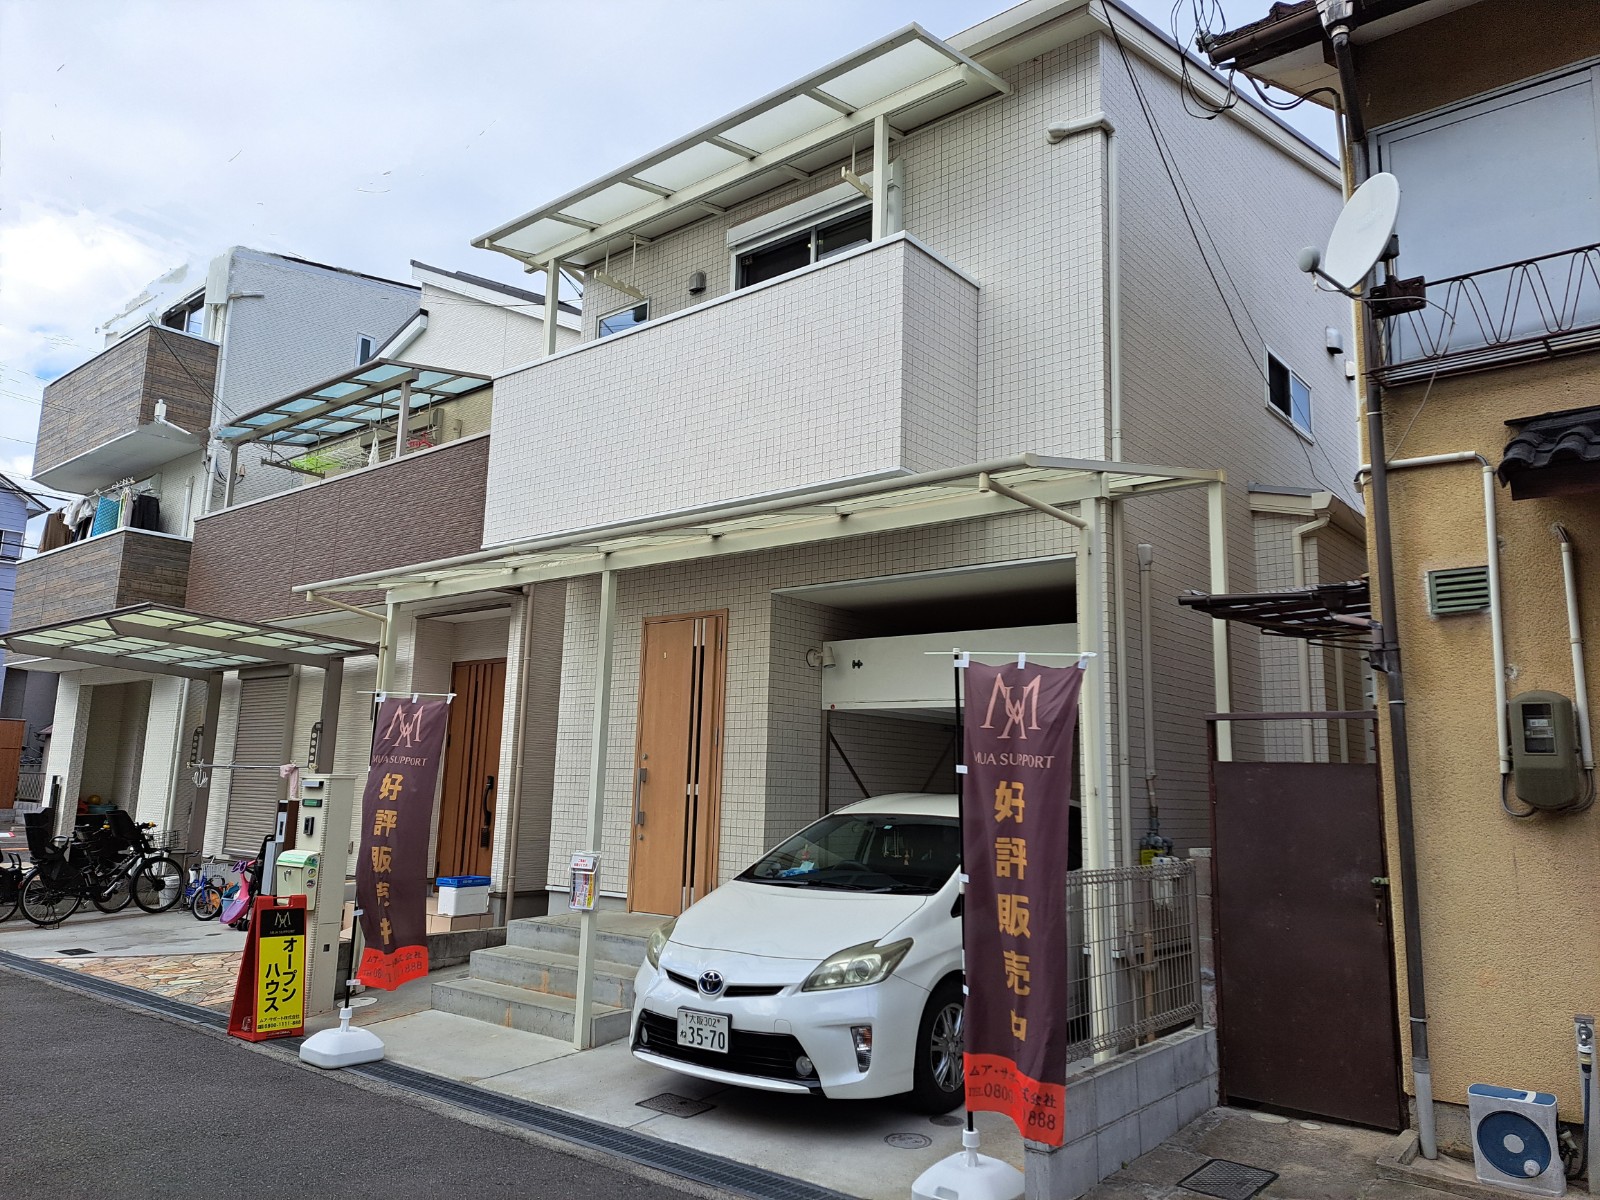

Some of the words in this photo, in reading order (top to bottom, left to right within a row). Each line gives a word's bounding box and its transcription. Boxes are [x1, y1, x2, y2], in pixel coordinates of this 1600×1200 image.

[372, 754, 388, 765] MUA
[389, 755, 428, 767] SUPPORT
[973, 751, 997, 766] MUA
[1000, 753, 1056, 769] SUPPORT
[282, 937, 298, 1003] オープン
[264, 963, 280, 1013] ハウス
[680, 1029, 687, 1039] ね
[688, 1026, 726, 1050] 35-70
